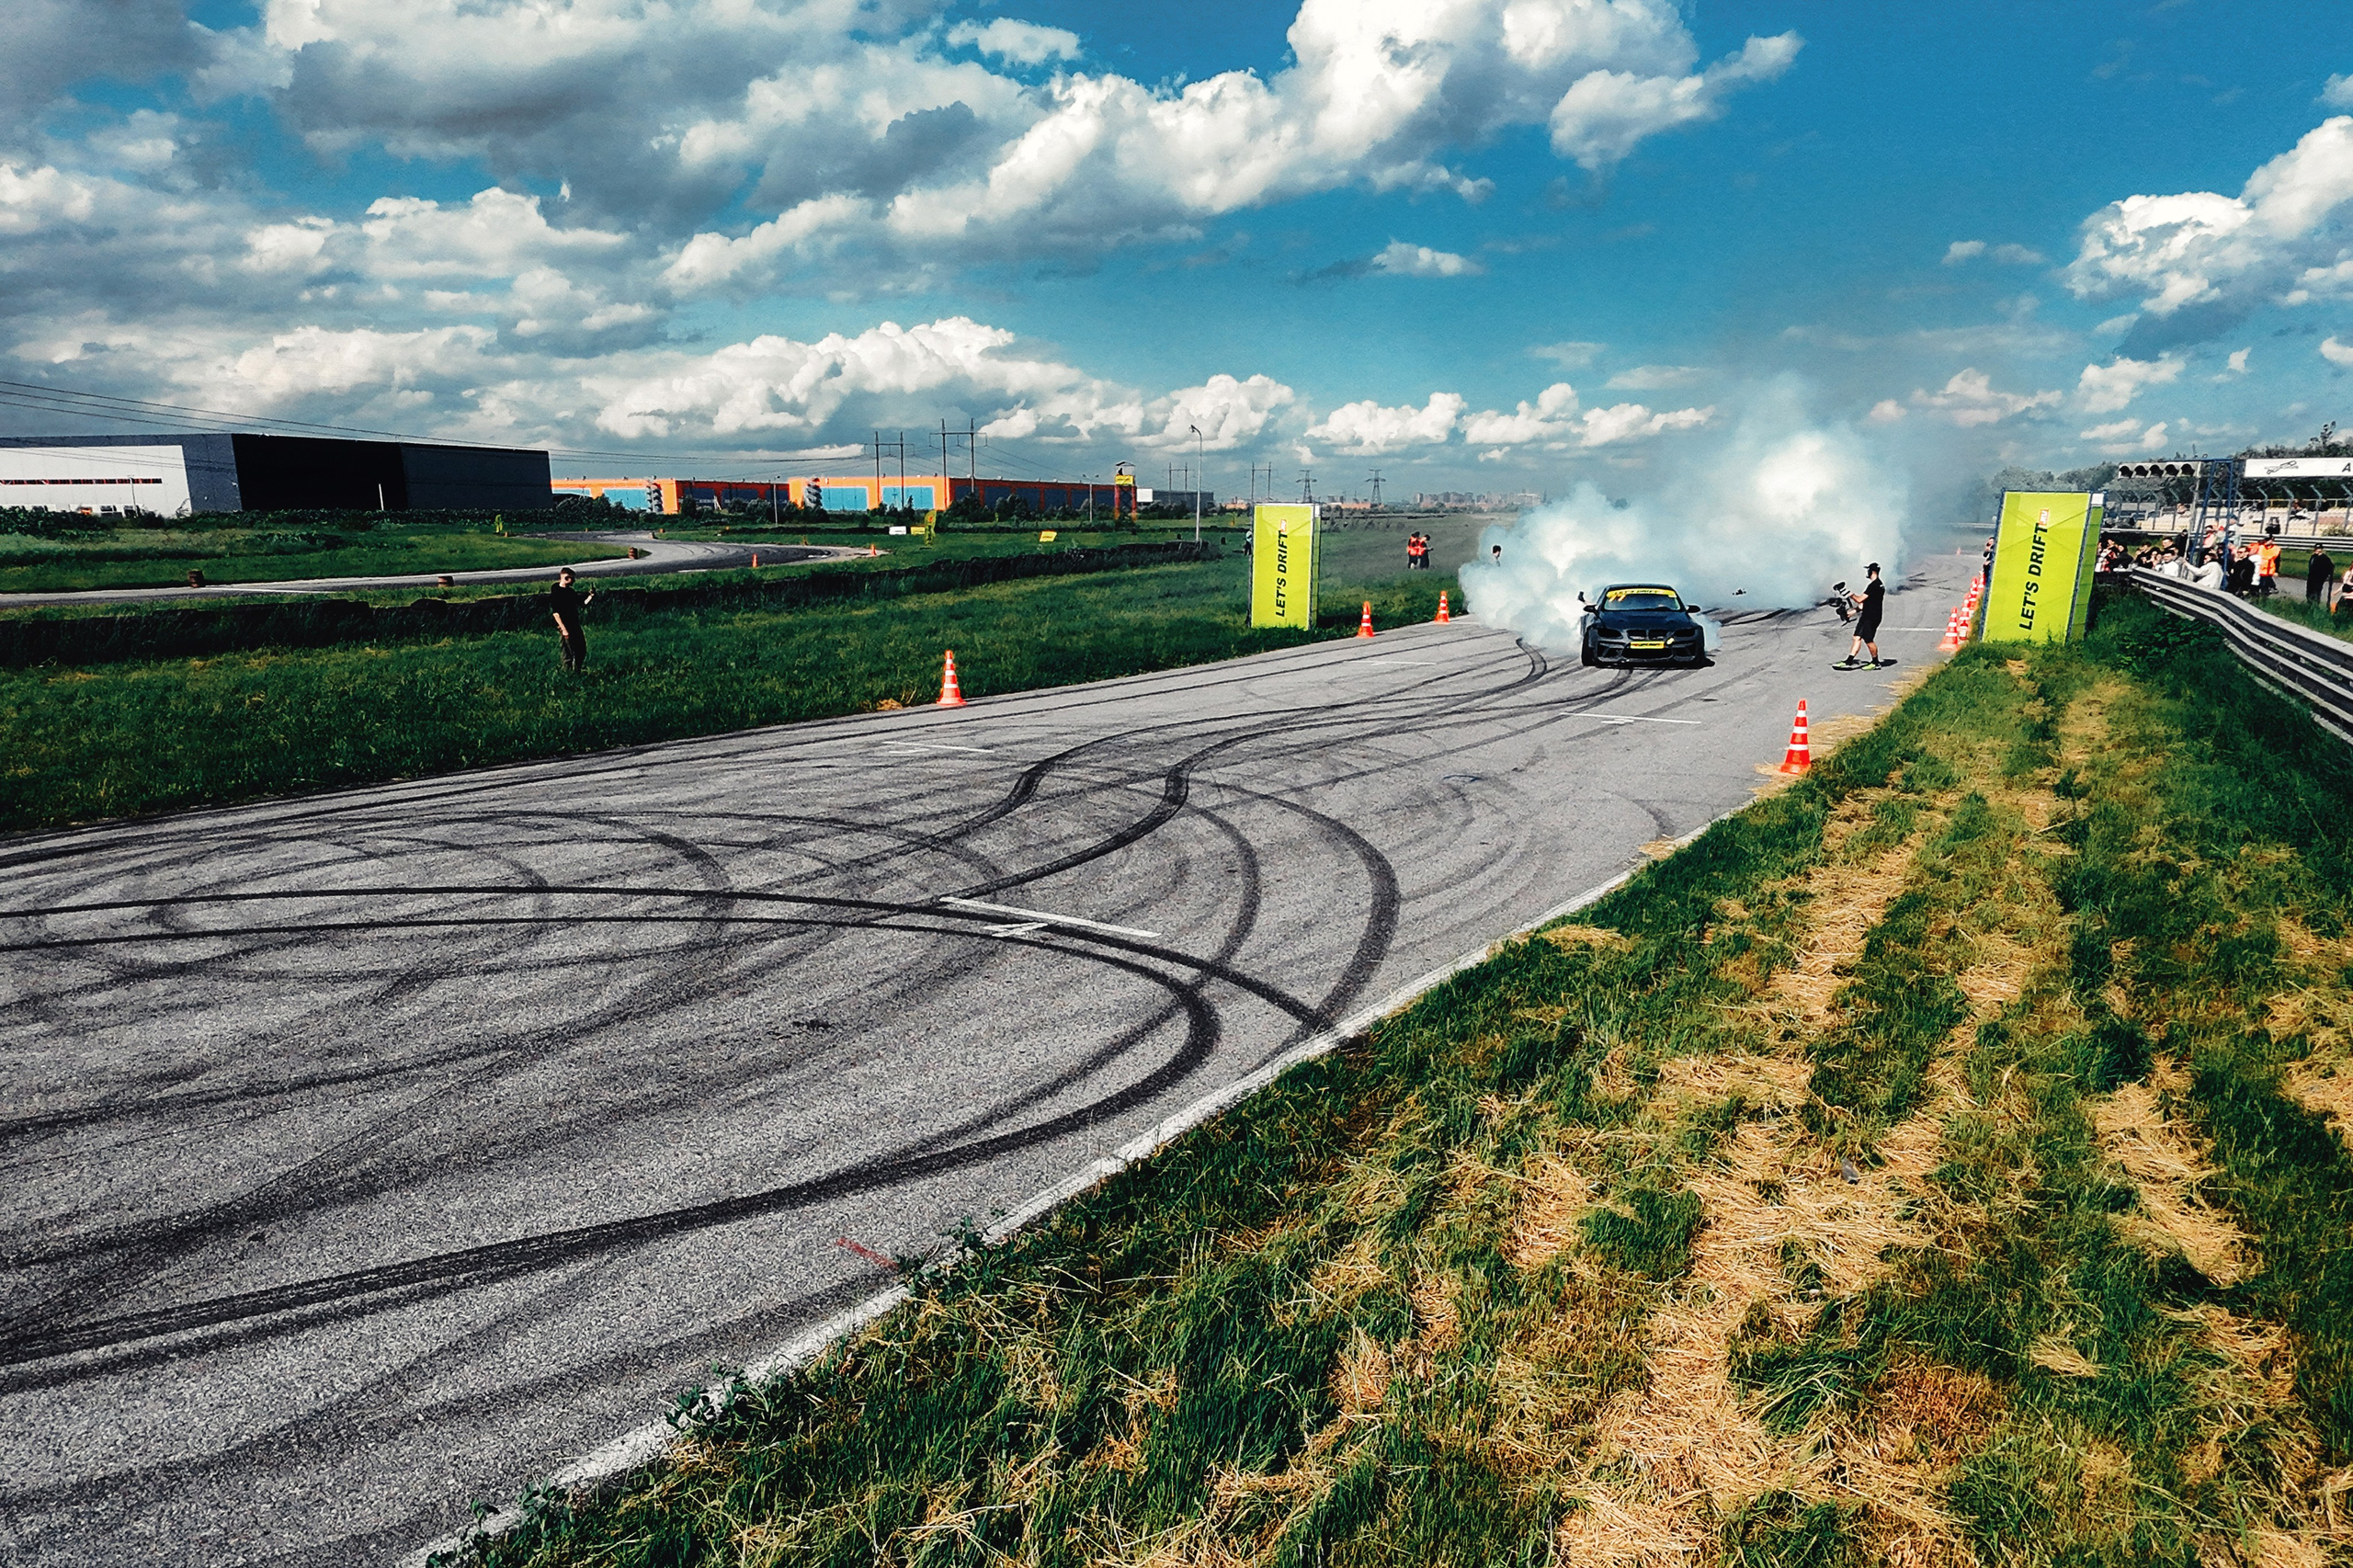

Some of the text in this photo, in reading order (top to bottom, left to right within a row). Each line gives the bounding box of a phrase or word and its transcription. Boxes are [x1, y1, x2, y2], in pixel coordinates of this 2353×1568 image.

[1277, 529, 1288, 574] DRIFT
[2028, 522, 2048, 577] DRIFT
[1275, 577, 1287, 618] LET'S
[2019, 581, 2039, 631] LET'S
